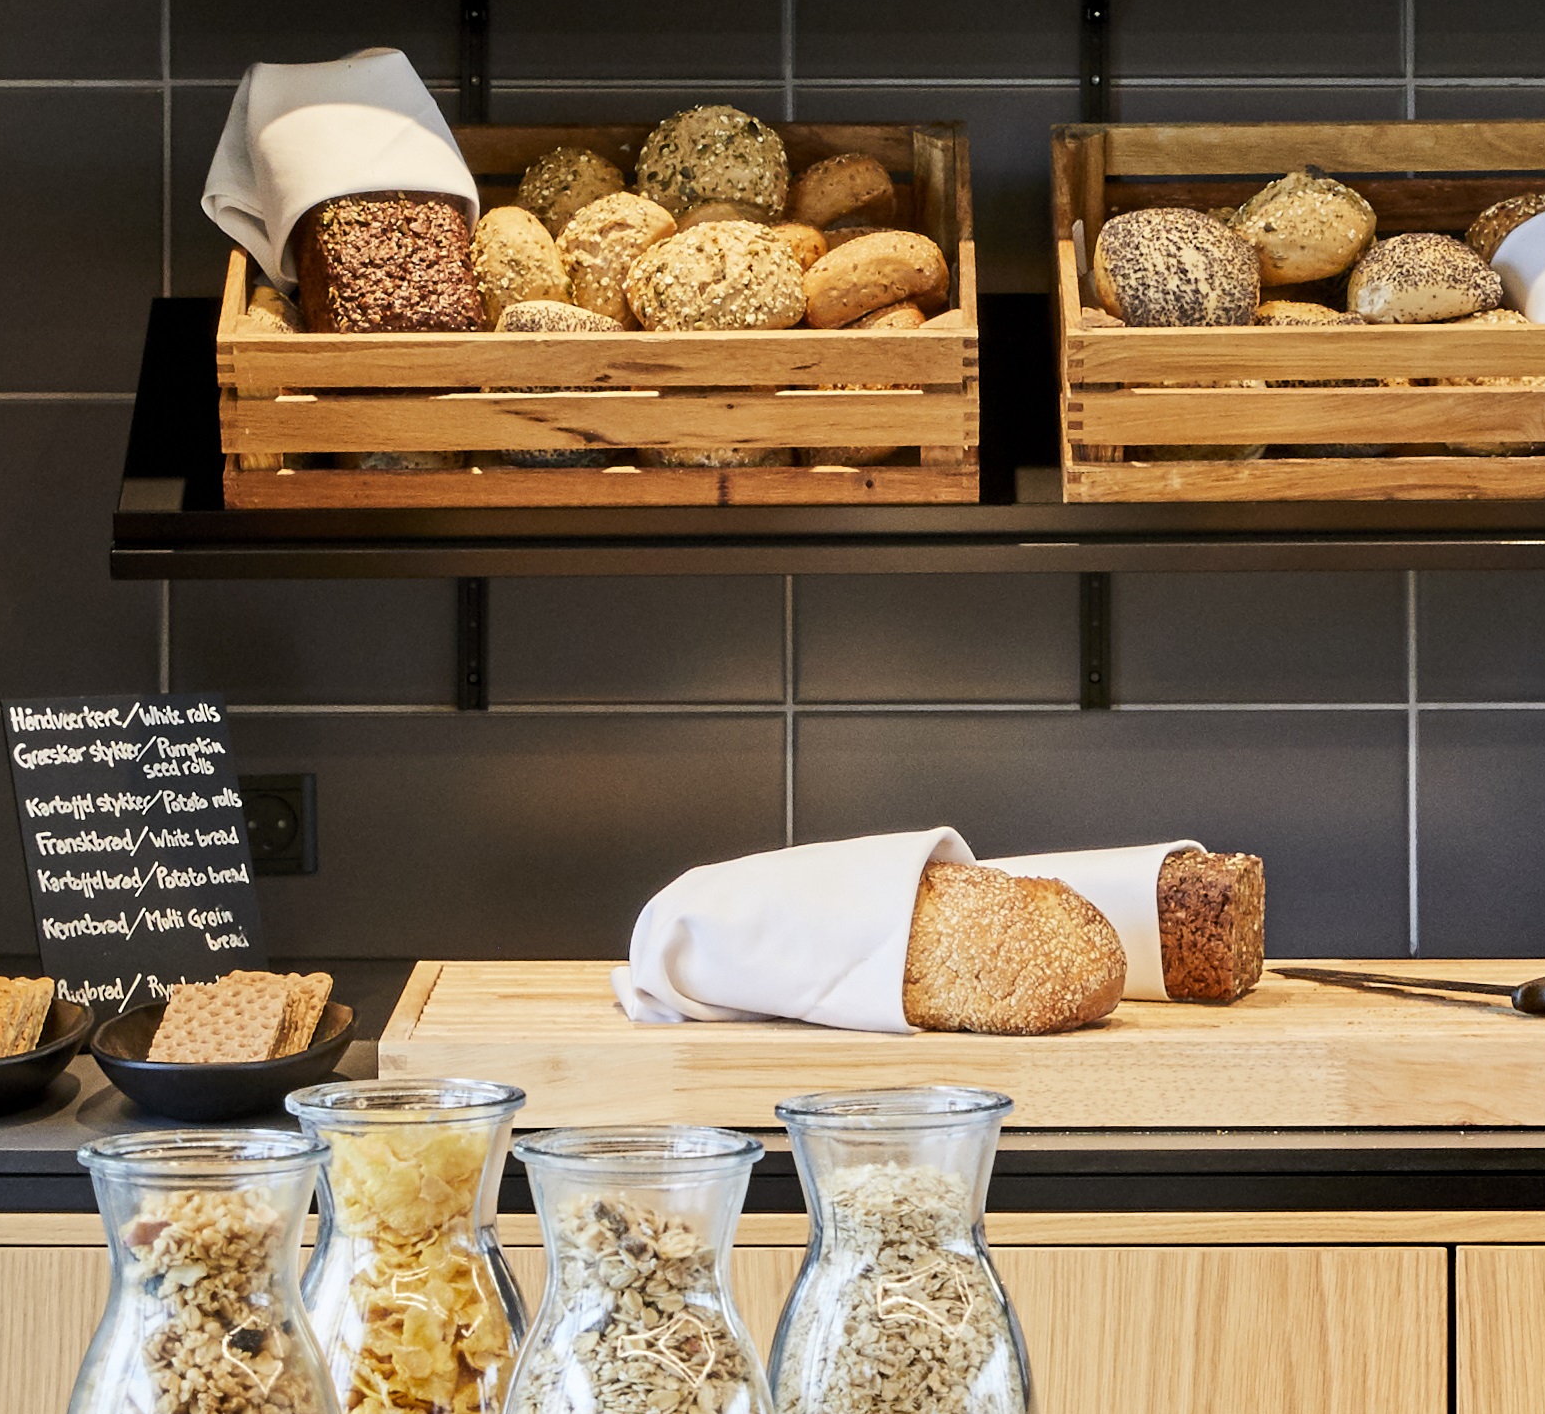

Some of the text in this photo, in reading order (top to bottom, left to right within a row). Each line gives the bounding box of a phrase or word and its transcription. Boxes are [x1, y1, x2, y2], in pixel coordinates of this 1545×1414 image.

[186, 702, 221, 724] rolls
[14, 743, 86, 770] Græskar
[143, 757, 215, 779] seed rolls
[212, 787, 243, 808] rolls
[195, 825, 240, 848] bread
[208, 863, 250, 885] bread
[187, 907, 234, 930] Grain
[205, 926, 250, 951] bread
